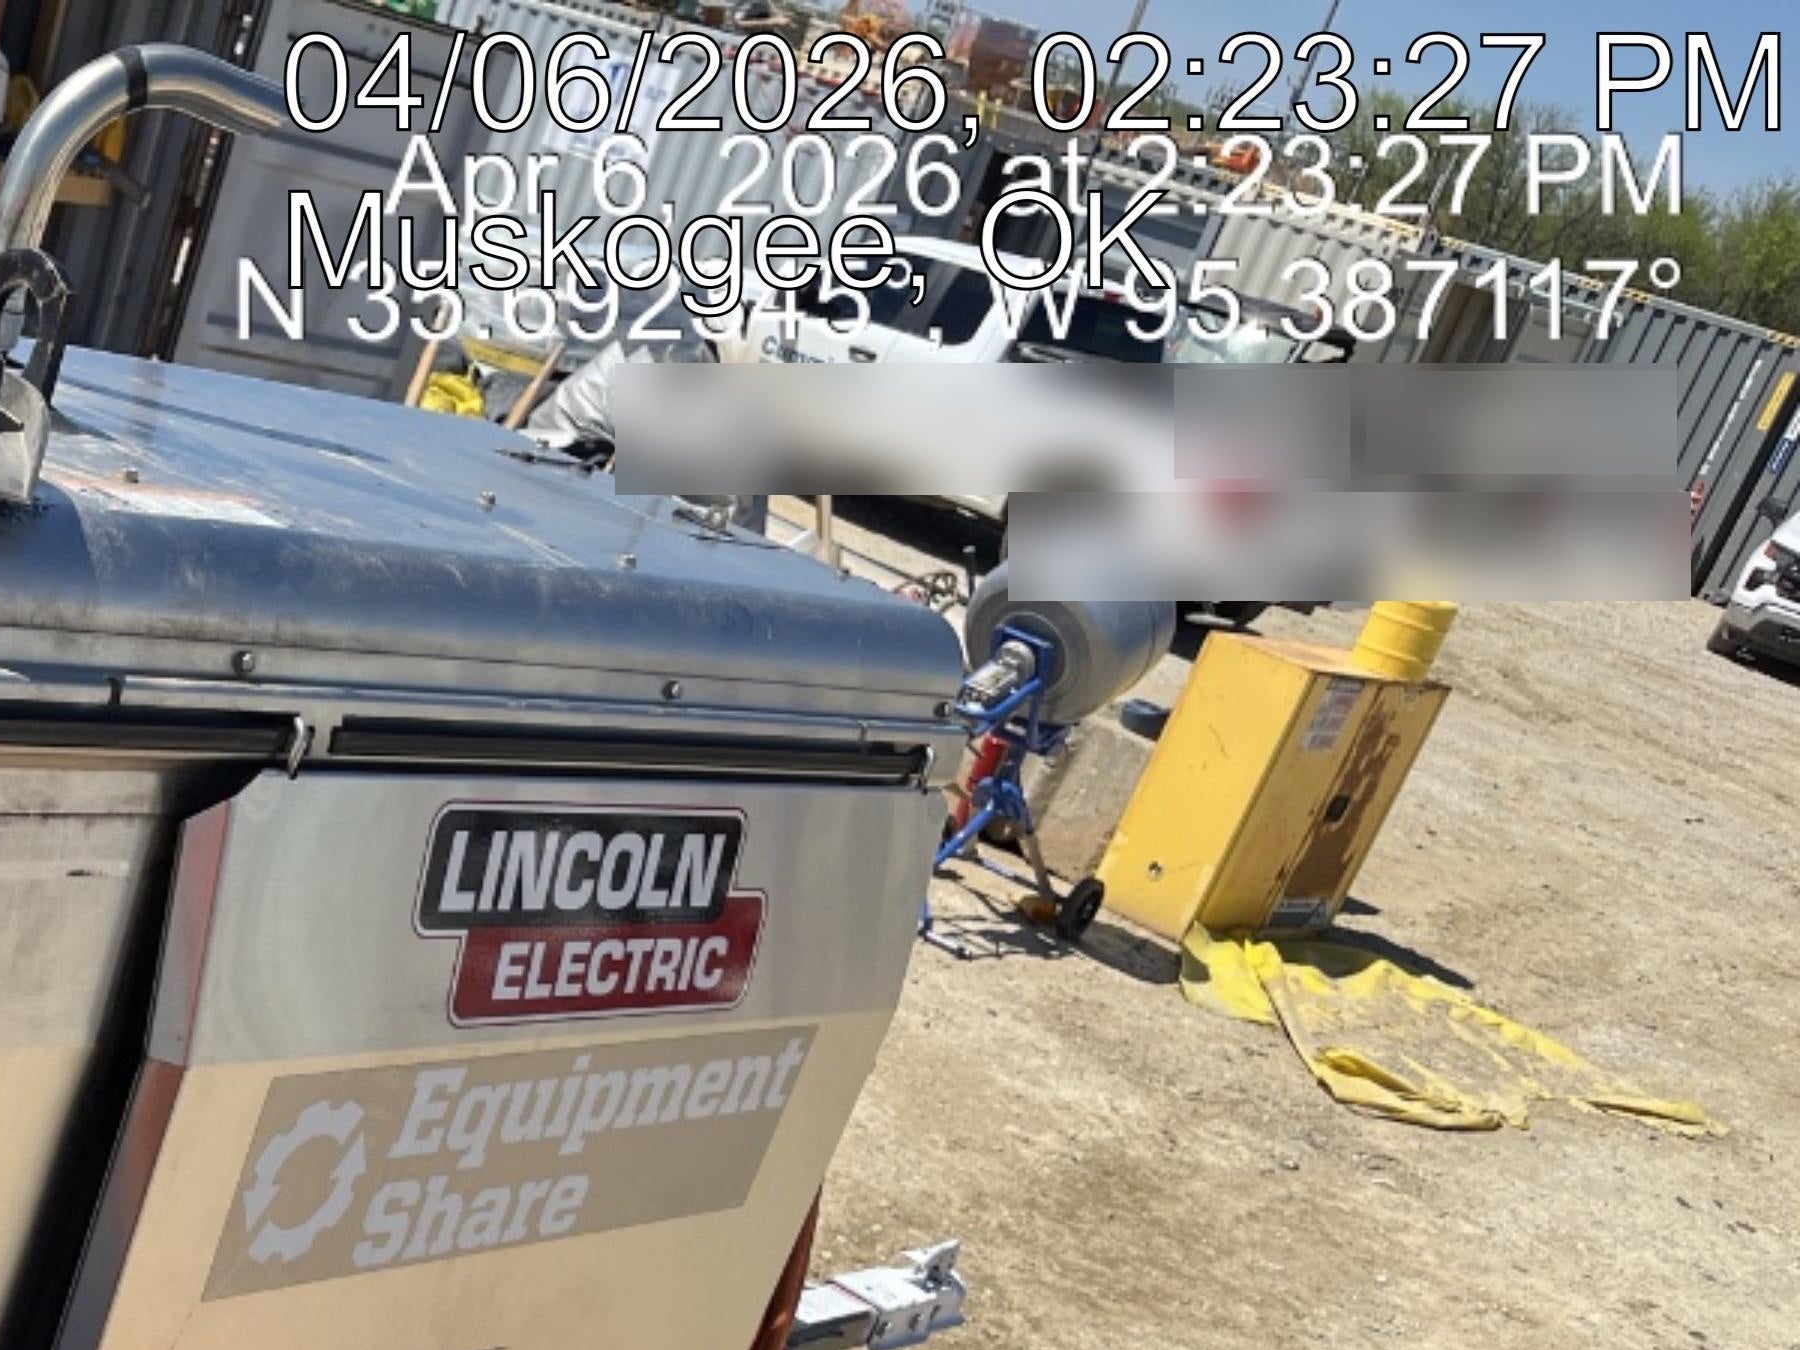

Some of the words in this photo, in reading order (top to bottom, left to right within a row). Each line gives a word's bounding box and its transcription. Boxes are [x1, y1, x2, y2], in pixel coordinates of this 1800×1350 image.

[437, 830, 727, 914] LINCOLN
[491, 936, 728, 1001] ELECTRIC
[389, 1037, 804, 1170] Equipment
[353, 1172, 589, 1269] Share
